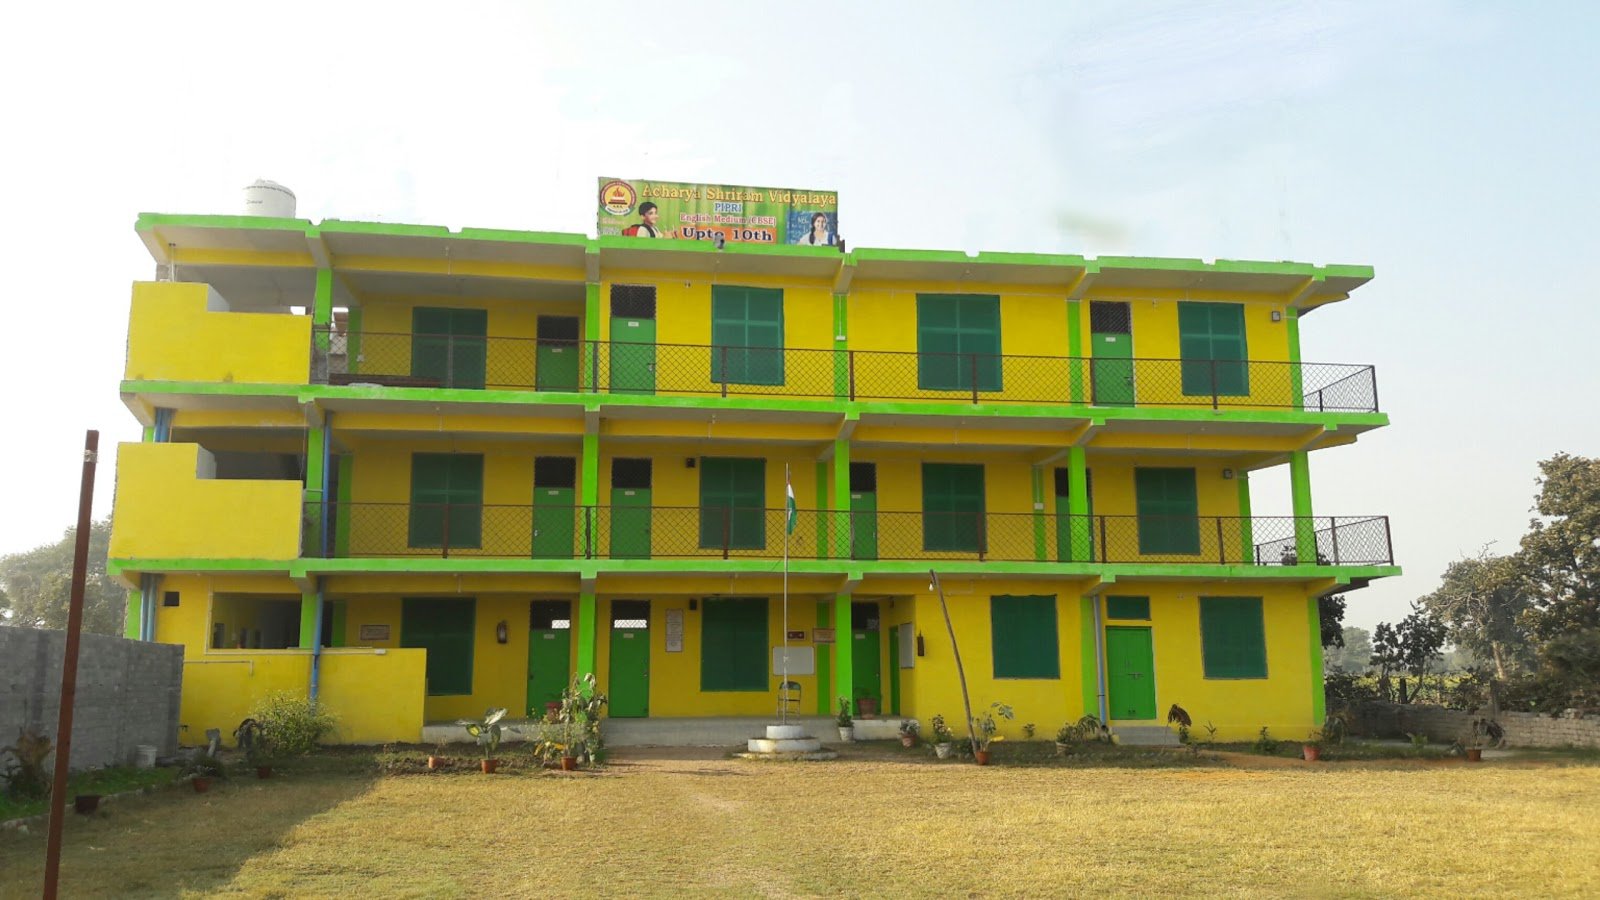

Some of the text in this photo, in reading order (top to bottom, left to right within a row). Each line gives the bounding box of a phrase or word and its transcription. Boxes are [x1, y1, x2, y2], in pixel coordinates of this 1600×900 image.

[642, 182, 702, 202] Acharya
[706, 187, 764, 202] Shriram
[768, 190, 836, 208] Vidyalaya
[714, 202, 742, 213] PIPRI
[680, 213, 711, 223] English
[714, 214, 746, 224] Medium
[733, 229, 772, 241] 10th
